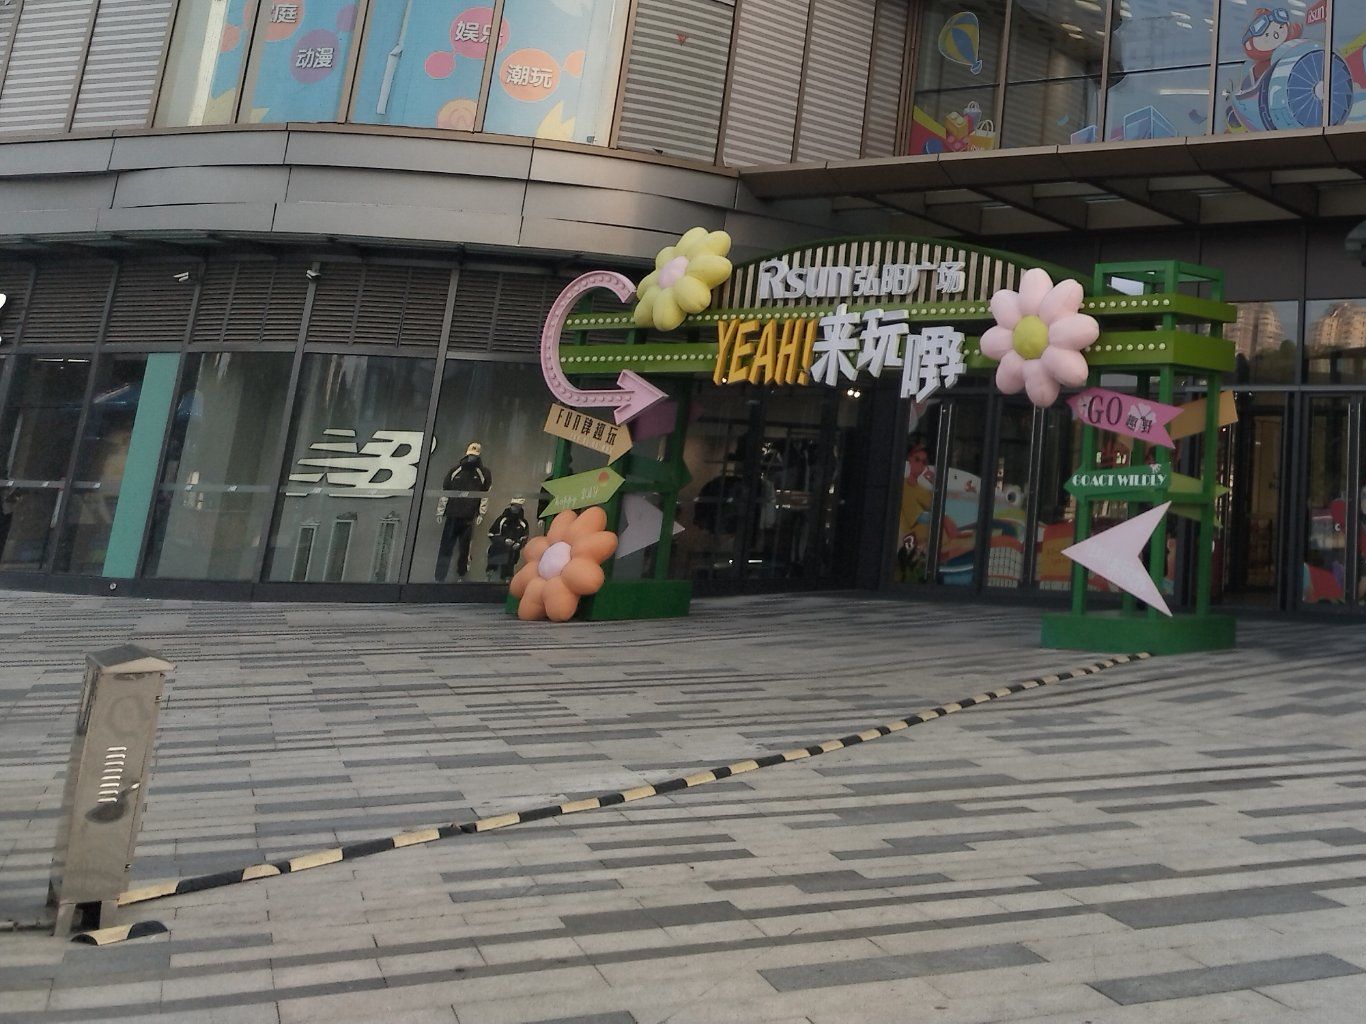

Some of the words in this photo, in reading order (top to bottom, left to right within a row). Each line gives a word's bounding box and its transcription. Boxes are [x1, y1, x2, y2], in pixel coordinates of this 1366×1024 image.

[295, 47, 334, 68] 动漫
[506, 63, 553, 88] 潮玩
[713, 318, 817, 386] YEAH!
[1087, 394, 1123, 426] GO
